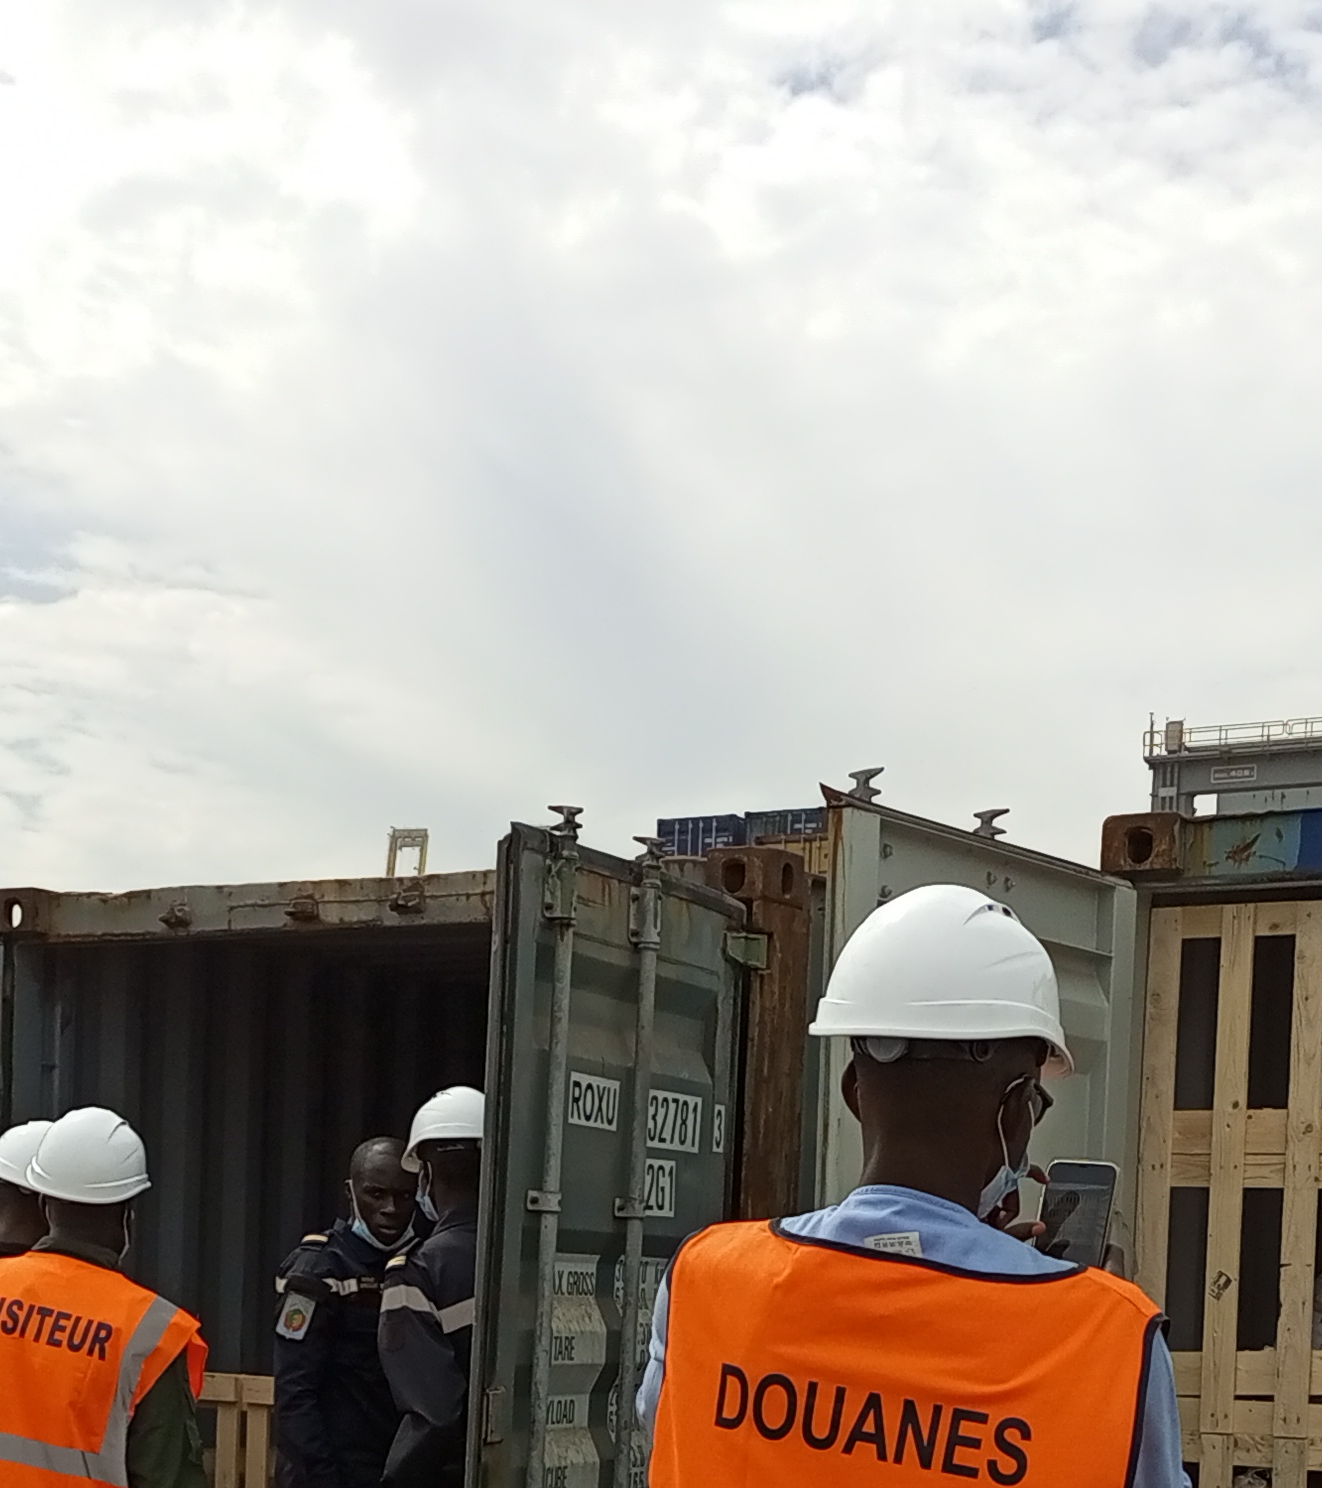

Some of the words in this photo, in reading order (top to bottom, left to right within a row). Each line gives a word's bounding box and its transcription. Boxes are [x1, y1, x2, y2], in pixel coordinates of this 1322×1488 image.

[570, 1079, 617, 1127] ROXU
[647, 1094, 699, 1148] 32781
[714, 1108, 723, 1150] 3
[644, 1163, 674, 1212] 2G1
[553, 1336, 576, 1362] TARE
[546, 1399, 576, 1425] YLOAD
[714, 1362, 1032, 1486] DOUANES
